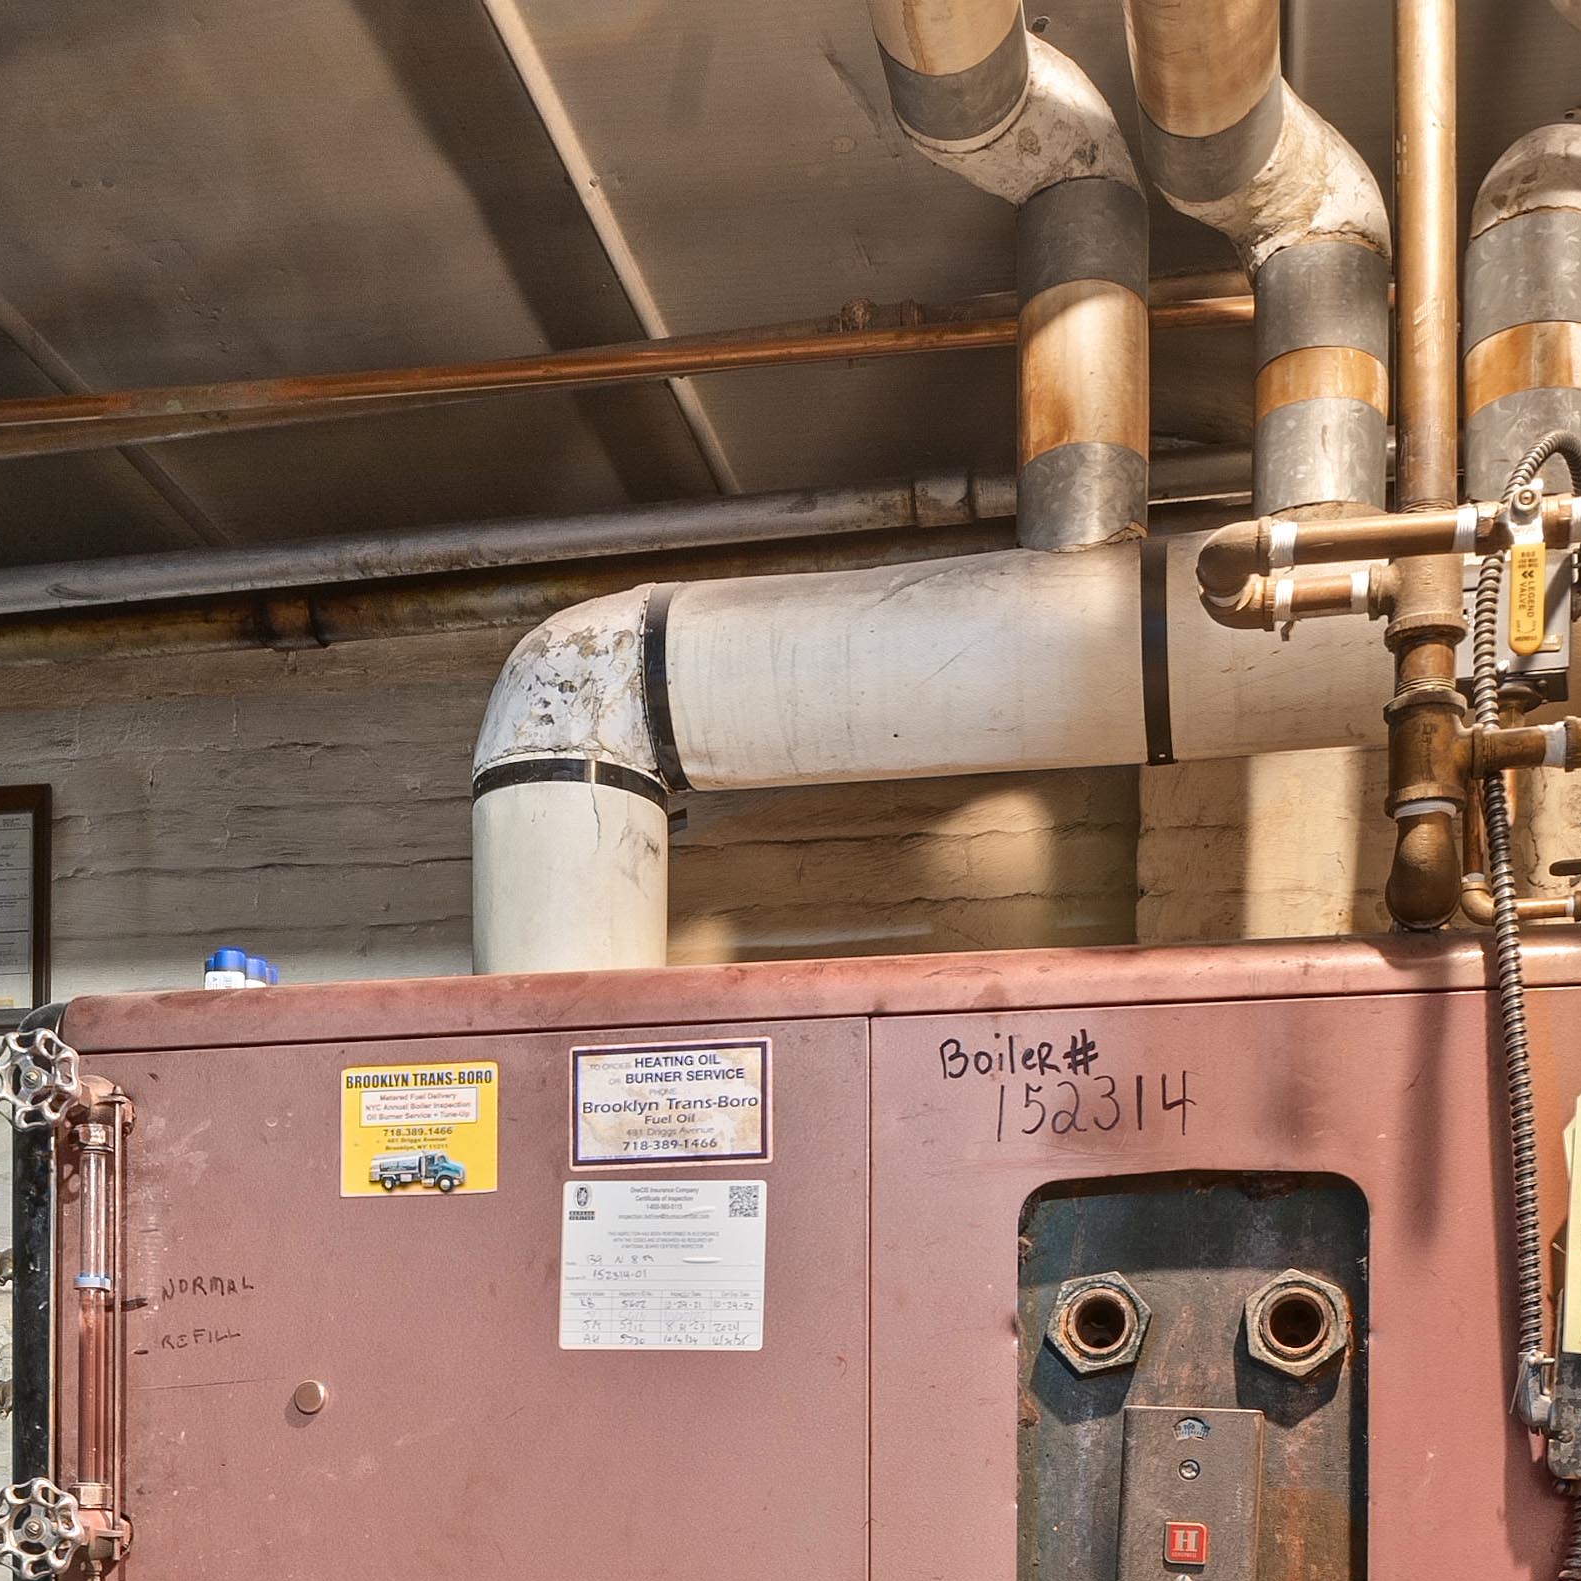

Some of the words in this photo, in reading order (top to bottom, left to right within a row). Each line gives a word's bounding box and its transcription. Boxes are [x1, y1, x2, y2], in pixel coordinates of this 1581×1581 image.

[1519, 581, 1527, 610] VALVE
[1527, 581, 1536, 618] LEGEND
[634, 1055, 694, 1068] HEATING
[698, 1054, 721, 1066] OIL
[346, 1073, 410, 1089] BROOKLYN
[412, 1070, 492, 1087] TRANS-BORO
[625, 1071, 682, 1084] BURNER
[686, 1068, 745, 1081] SERVICE
[410, 1092, 426, 1100] Fuel
[427, 1091, 456, 1101] Delivery
[365, 1104, 382, 1112] NYC
[383, 1103, 408, 1111] Annual
[410, 1102, 432, 1110] Boiler
[433, 1101, 471, 1111] Inspection
[582, 1099, 659, 1116] Brooklyn
[666, 1095, 758, 1111] Trans-Boro
[996, 1070, 1202, 1142] 152314
[405, 1112, 431, 1120] Service
[440, 1111, 469, 1120] Tune-Up
[644, 1114, 672, 1125] Fuel
[676, 1113, 695, 1123] Oil
[383, 1126, 453, 1137] 718.389.1466
[679, 1127, 715, 1135] Avenue
[623, 1139, 718, 1151] 718-389-1466
[161, 1276, 254, 1301] NORMAL
[161, 1328, 241, 1350] REFILL
[1172, 1530, 1199, 1552] H
